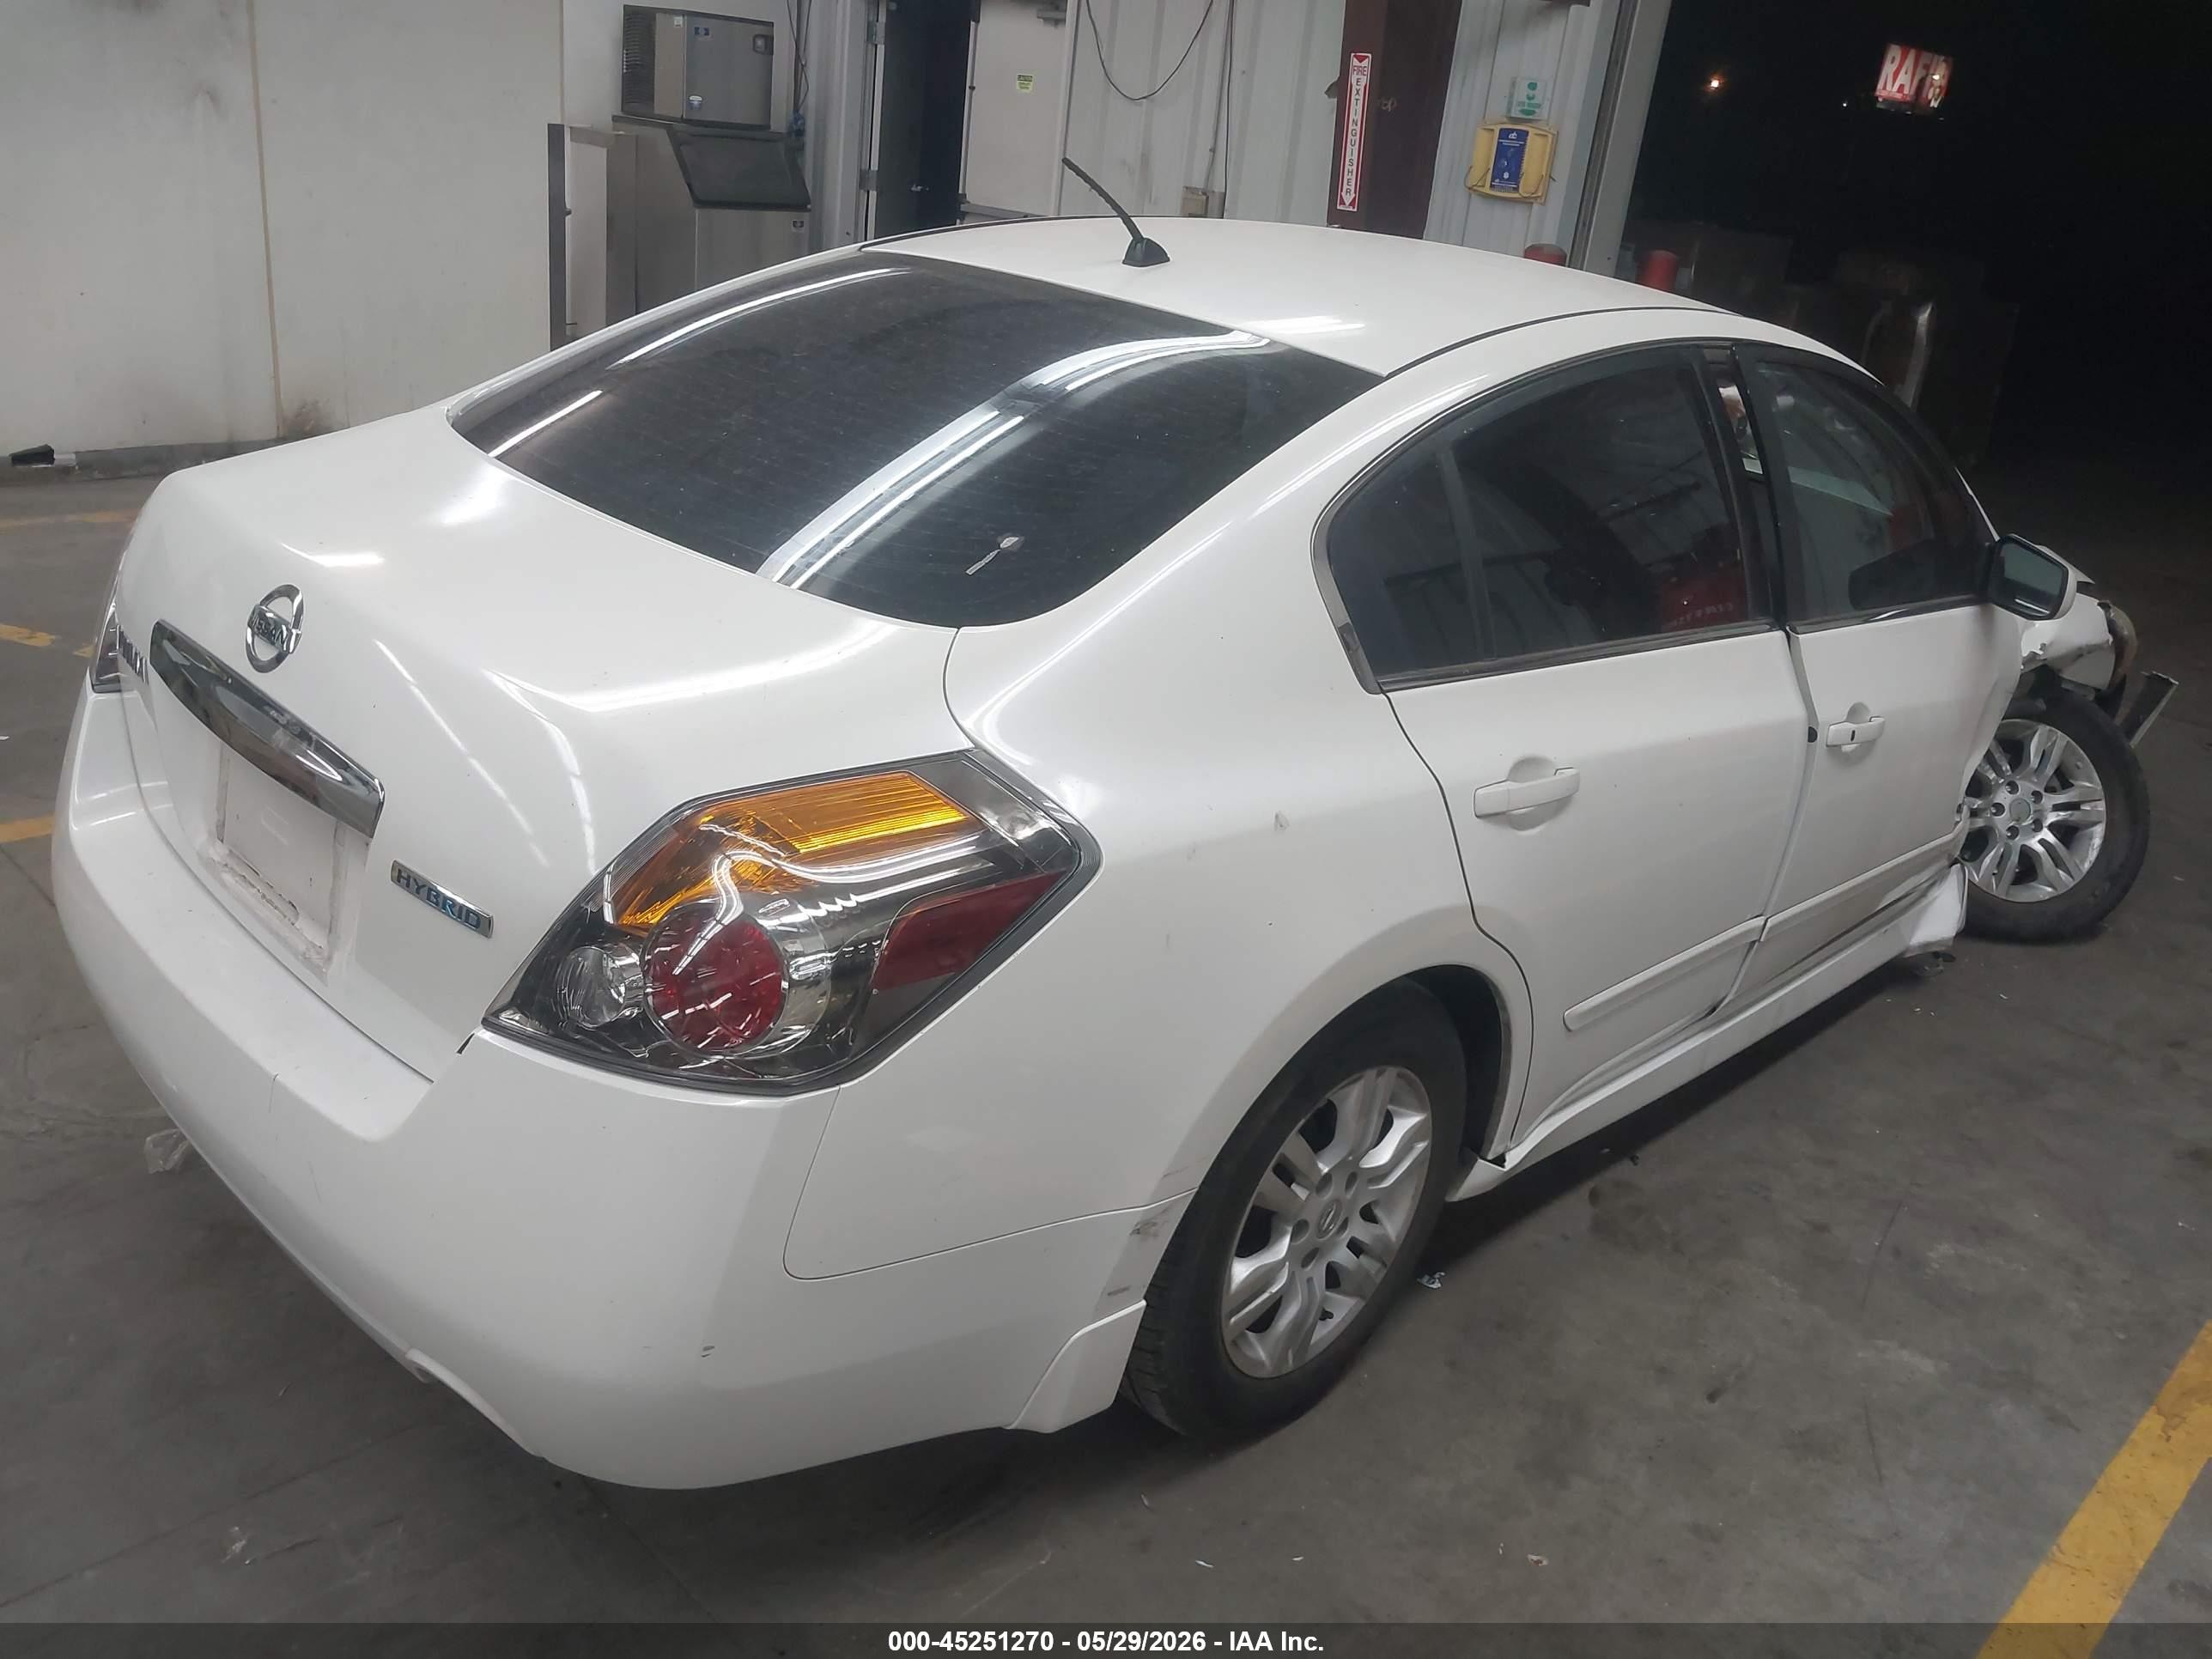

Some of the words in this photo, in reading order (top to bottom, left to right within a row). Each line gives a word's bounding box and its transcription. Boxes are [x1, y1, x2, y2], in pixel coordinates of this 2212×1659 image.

[1352, 66, 1367, 76] FIRE
[1346, 78, 1362, 196] EXTINGUISHER
[249, 609, 290, 652] NISSAN
[397, 867, 481, 929] HYBRID
